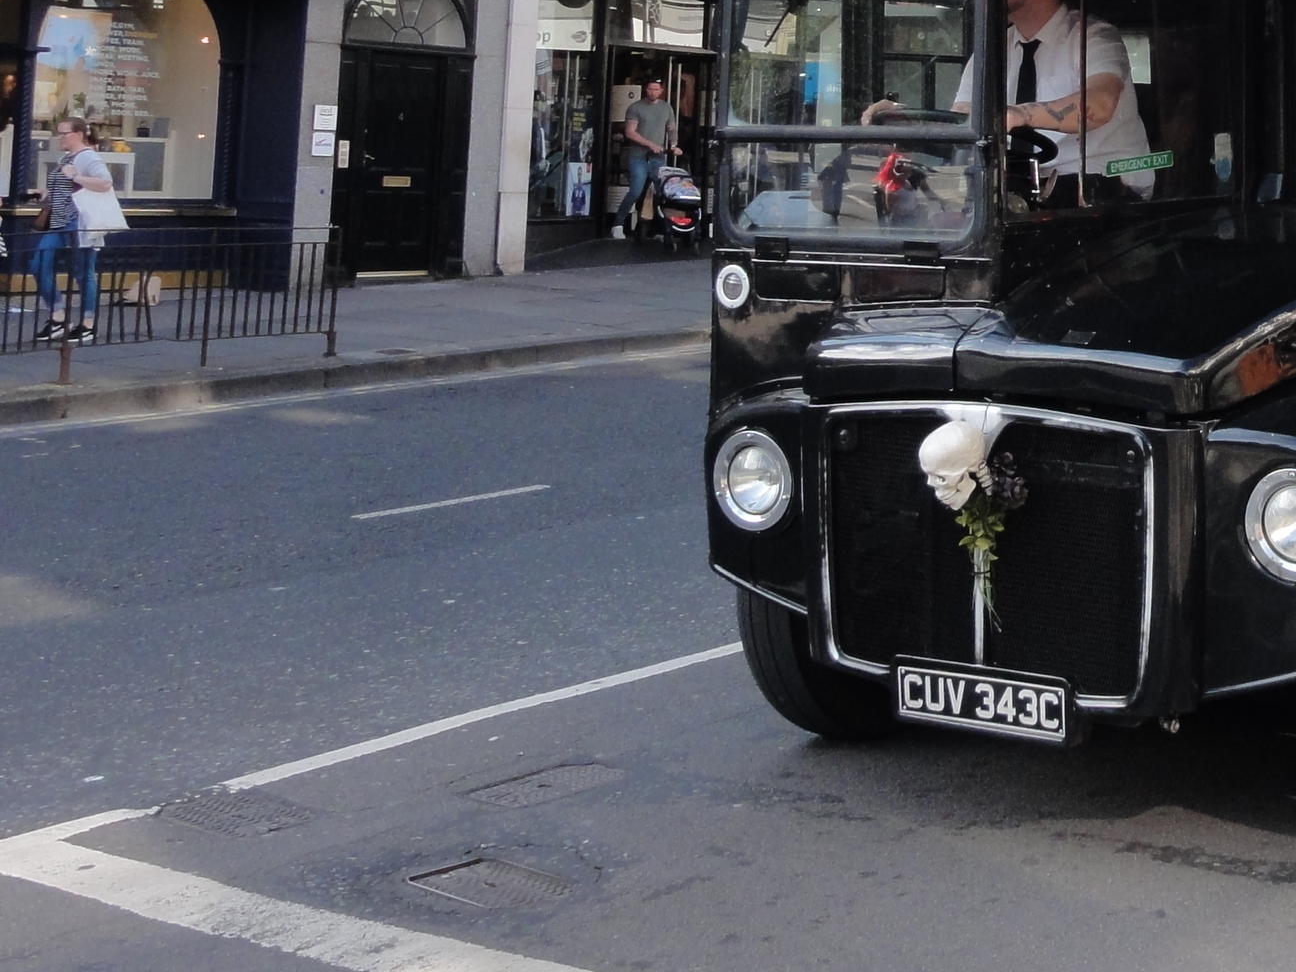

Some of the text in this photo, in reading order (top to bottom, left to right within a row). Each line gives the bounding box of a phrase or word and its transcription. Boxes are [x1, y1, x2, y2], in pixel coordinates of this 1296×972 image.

[1110, 154, 1169, 174] EMERGENCY EXIT
[903, 673, 1060, 730] CUV 343C
